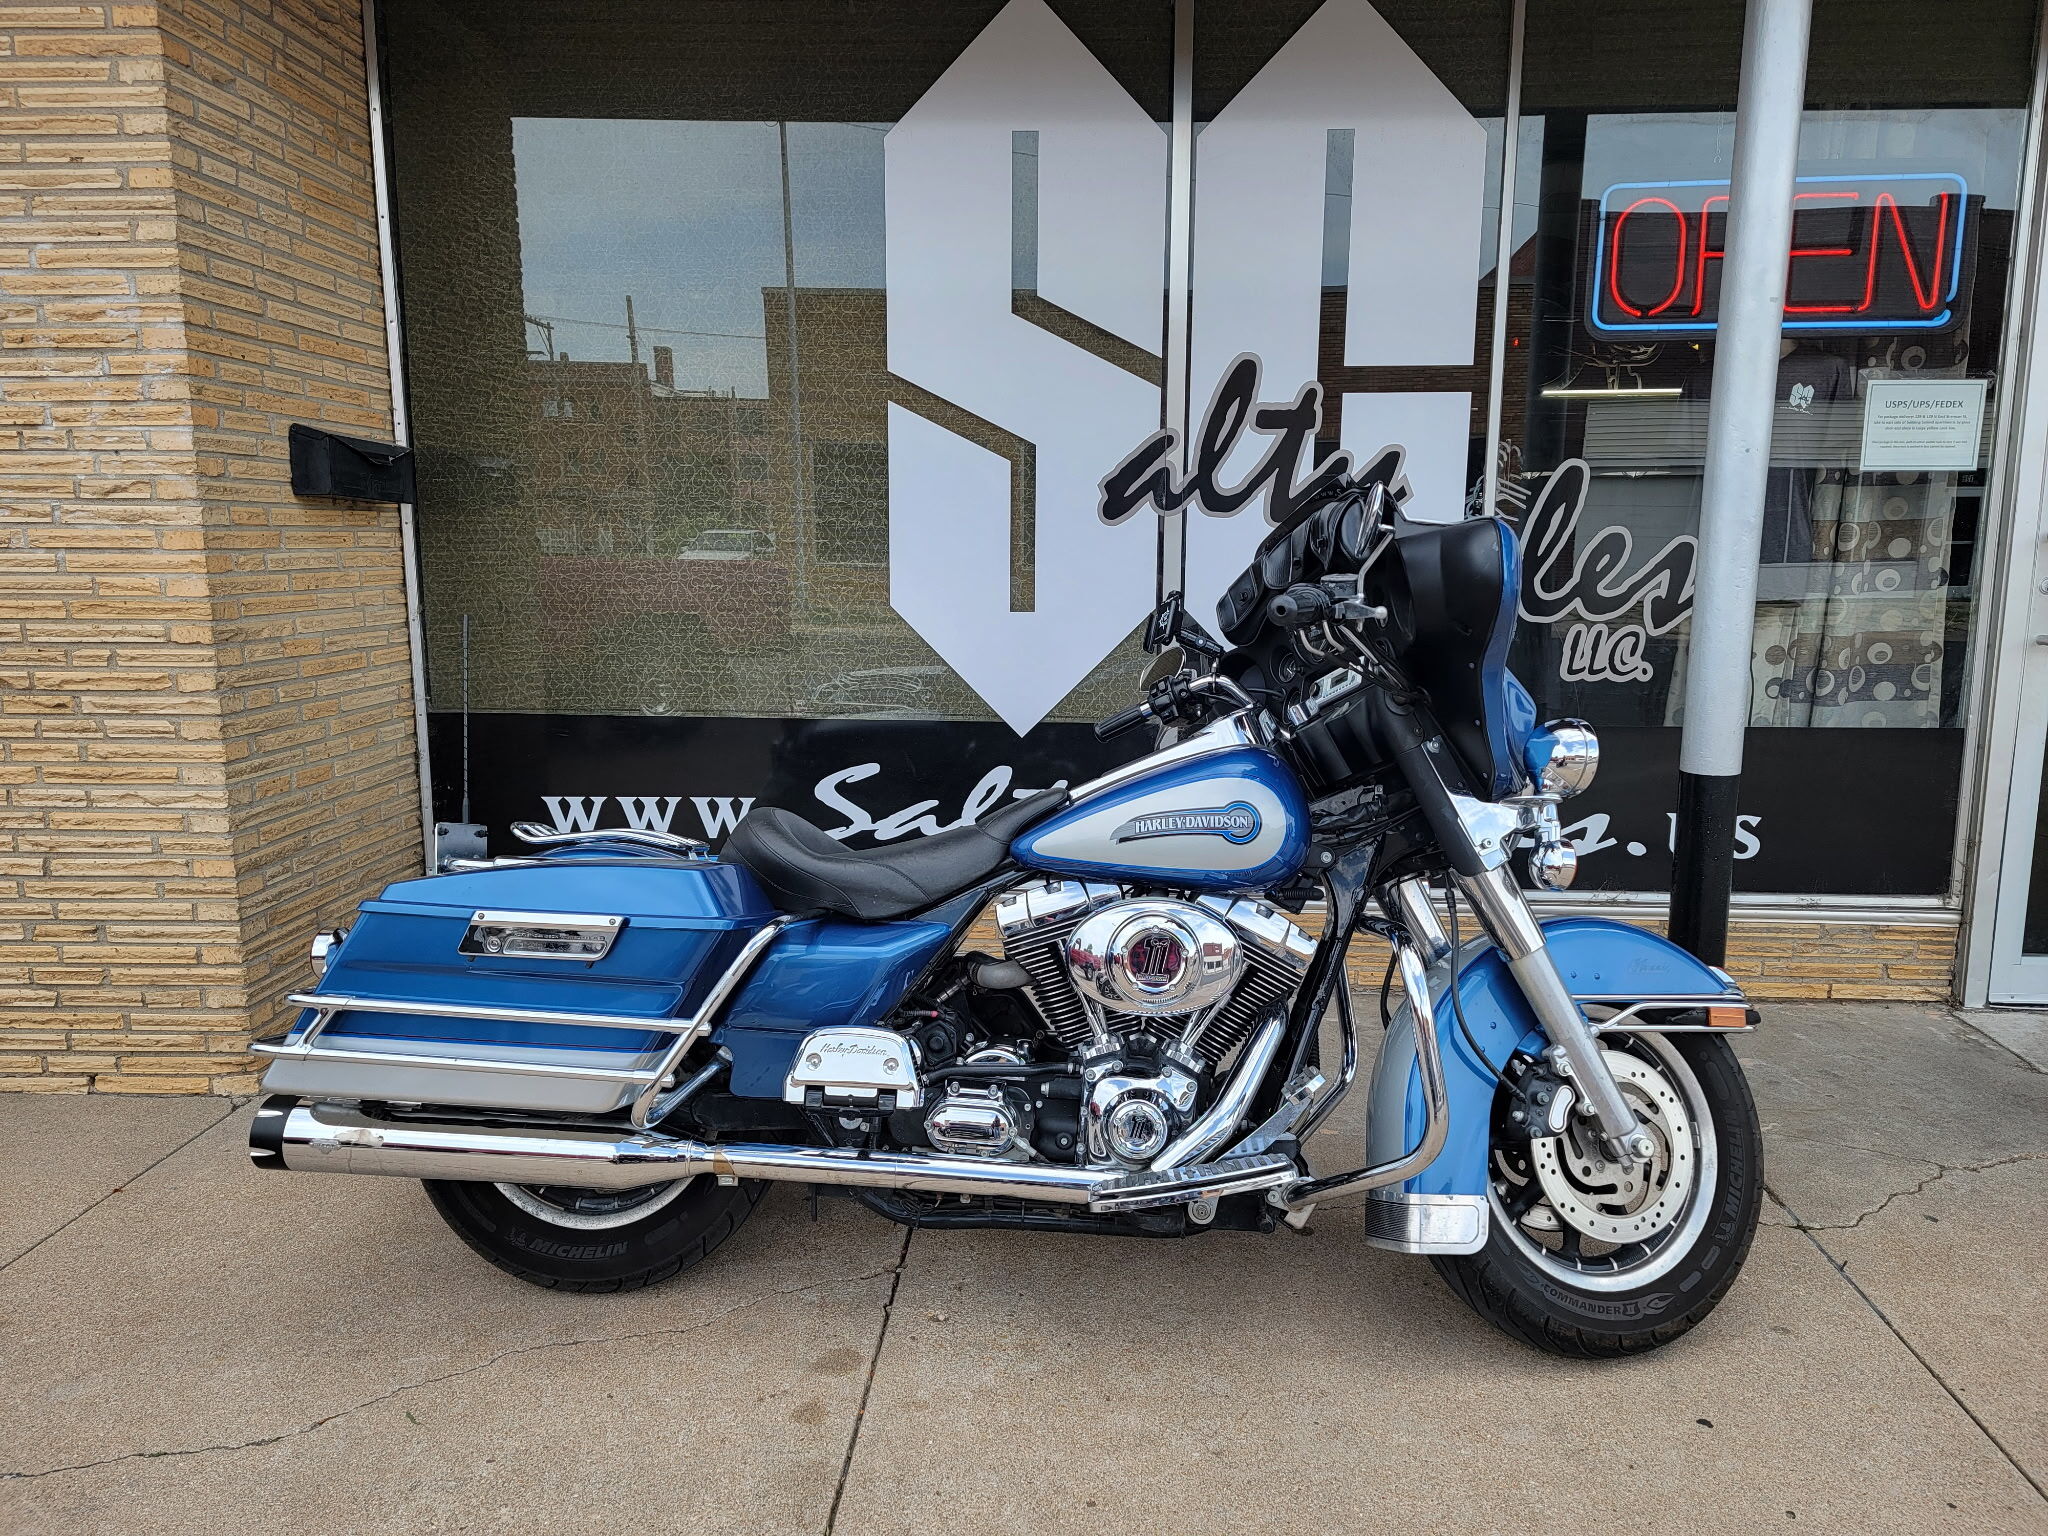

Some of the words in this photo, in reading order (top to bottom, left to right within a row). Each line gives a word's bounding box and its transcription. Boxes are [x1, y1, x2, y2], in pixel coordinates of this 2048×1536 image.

[1884, 399, 1964, 410] USPS/UPS/FEDEX
[529, 1239, 629, 1260] MICHELIN
[1541, 1283, 1622, 1315] COMMANDER
